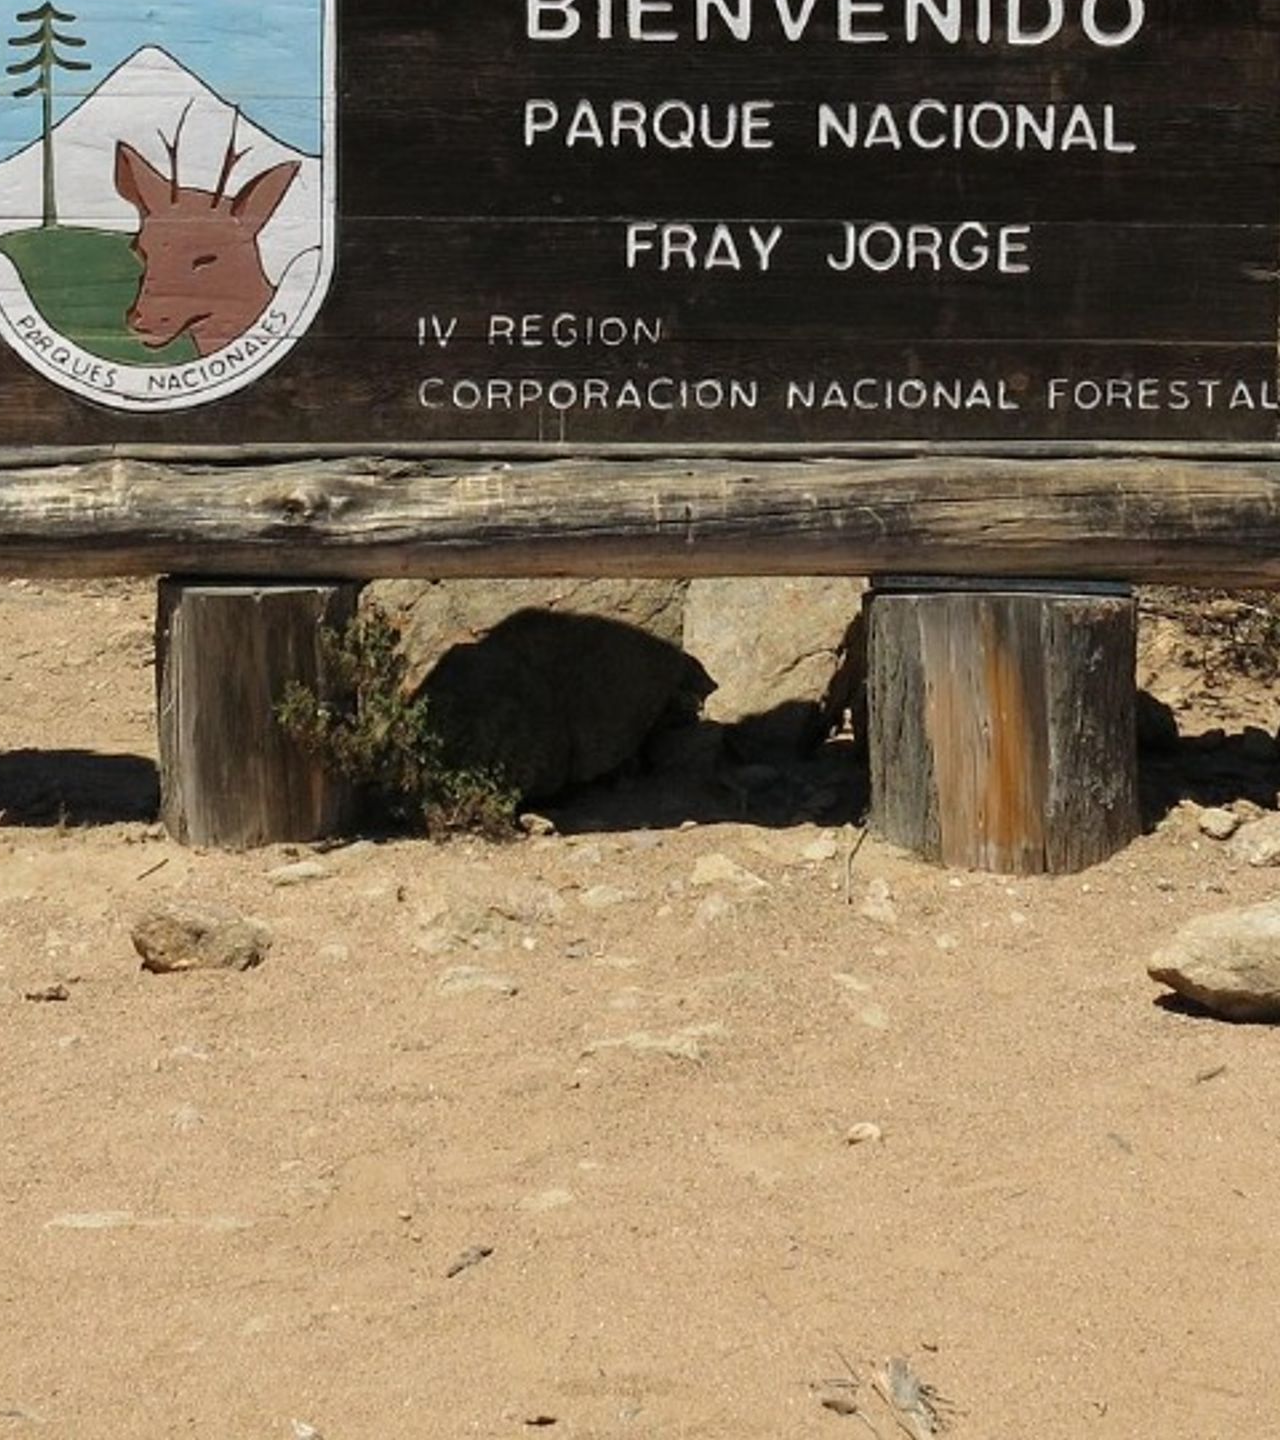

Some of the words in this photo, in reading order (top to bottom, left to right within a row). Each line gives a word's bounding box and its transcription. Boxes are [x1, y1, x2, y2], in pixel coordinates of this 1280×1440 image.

[524, 98, 774, 150] PARQUE
[817, 98, 1136, 154] NACIONAL
[626, 222, 782, 272] FRAY
[826, 221, 1032, 274] JORGE
[16, 314, 118, 388] PARQUES
[147, 308, 288, 391] NACIONALES
[418, 315, 457, 348] IV
[489, 313, 662, 348] REGION
[418, 377, 758, 411] CORPORACION
[786, 378, 1019, 411] NACIONAL
